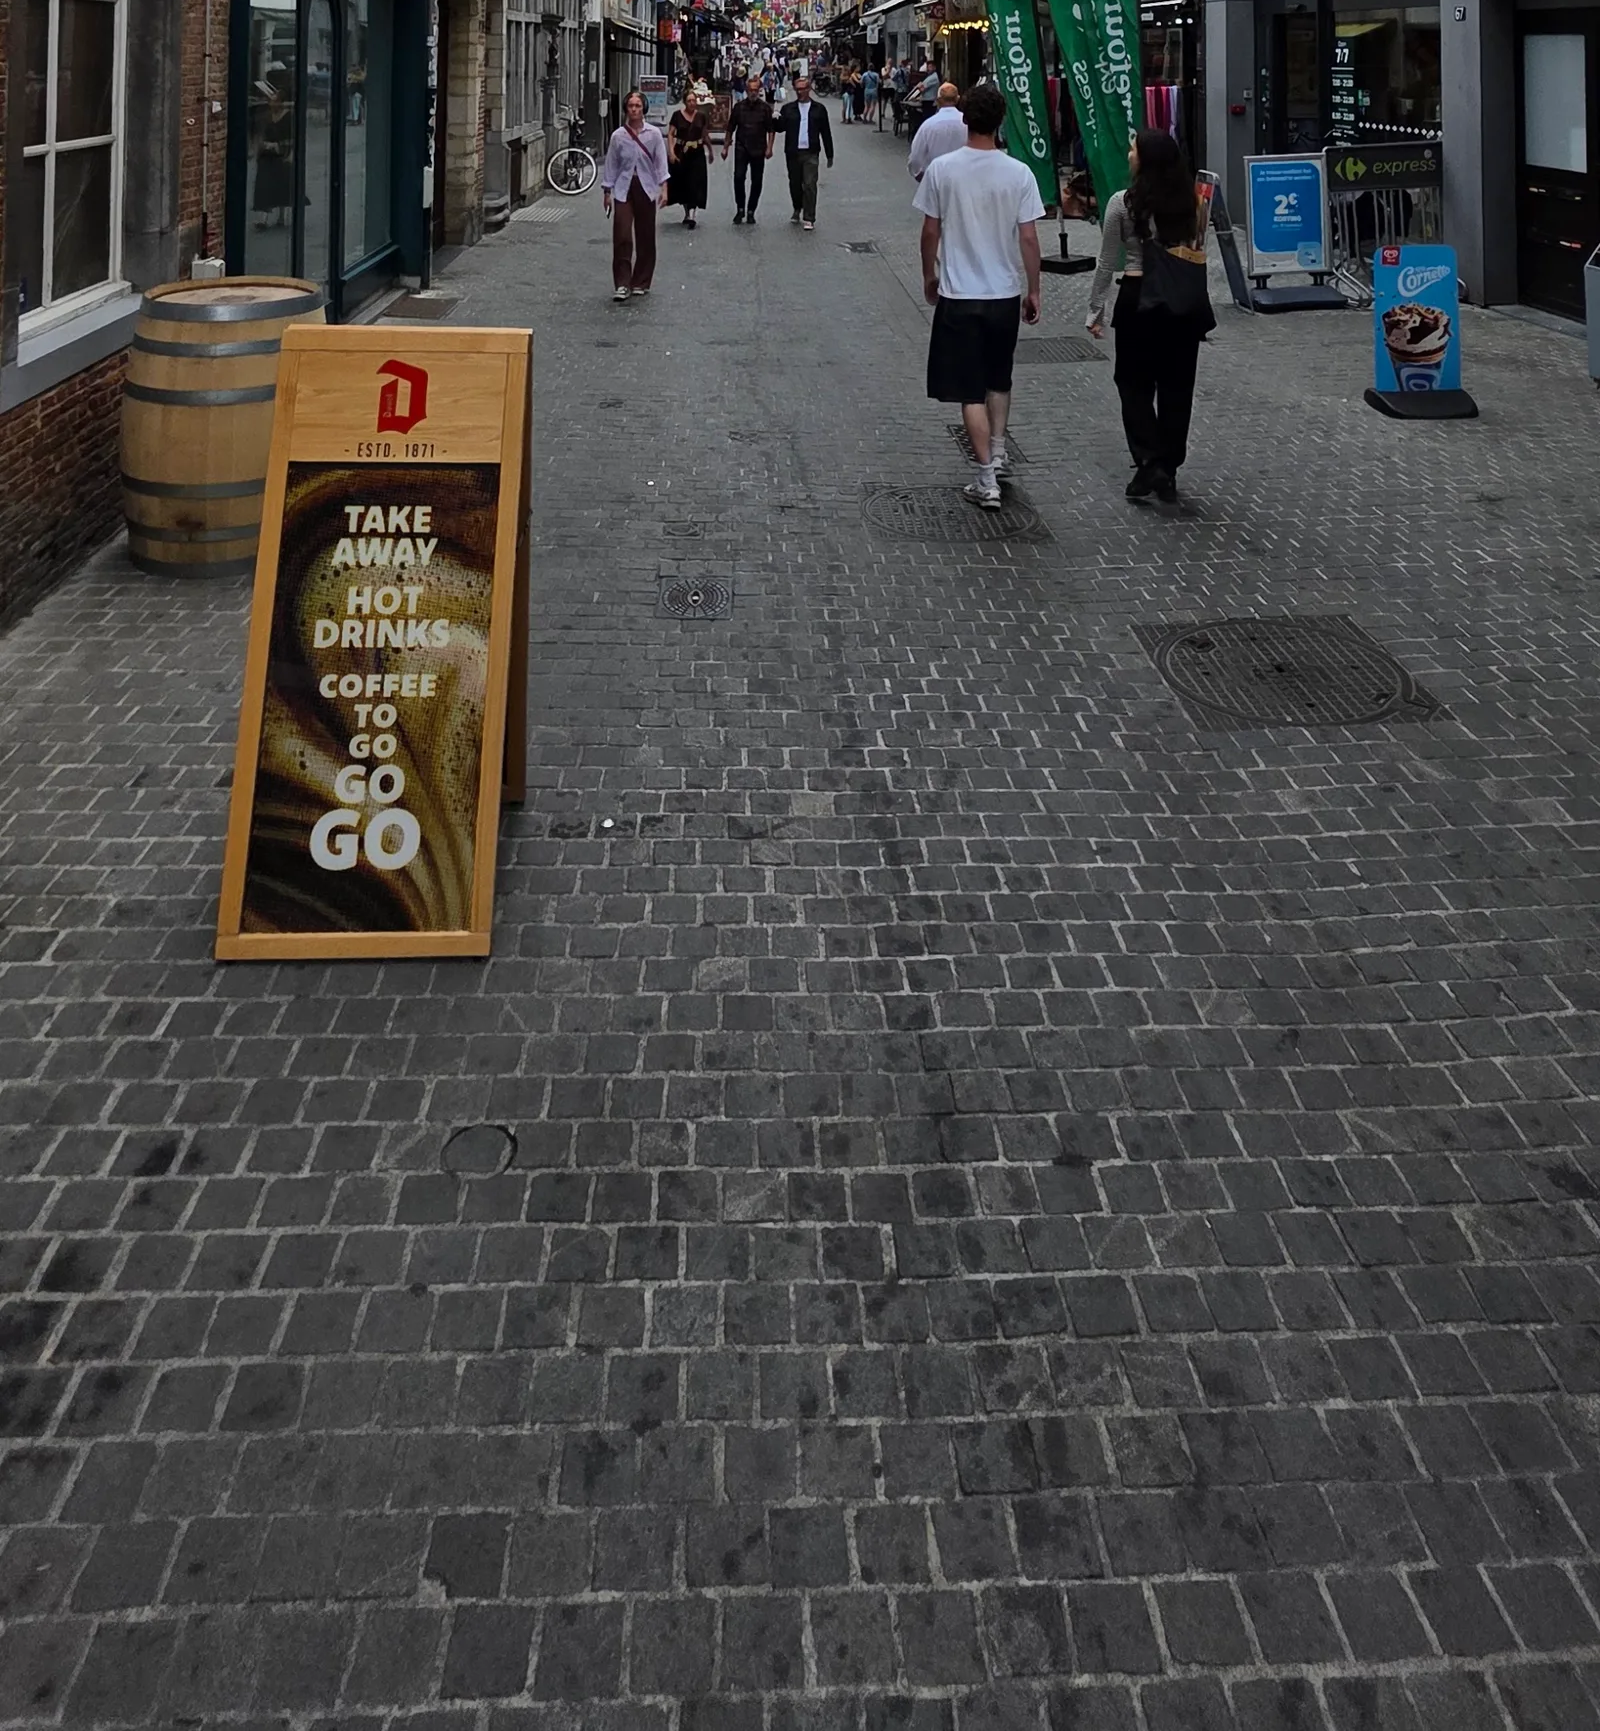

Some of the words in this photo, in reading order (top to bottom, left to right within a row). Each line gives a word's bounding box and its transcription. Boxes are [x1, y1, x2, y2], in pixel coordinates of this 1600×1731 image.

[1455, 7, 1464, 20] 67
[1373, 159, 1436, 176] express
[1398, 265, 1450, 297] Cornetto
[357, 442, 396, 458] ESTD.
[405, 443, 435, 458] 1871
[345, 506, 432, 534] TAKE
[331, 537, 438, 568] AWAY
[347, 586, 424, 617] HOT
[313, 618, 451, 650] DRINKS
[319, 673, 437, 699] COFFEE
[354, 704, 398, 729] TO
[349, 734, 397, 759] GO
[334, 765, 405, 805] GO
[309, 808, 422, 871] GO
